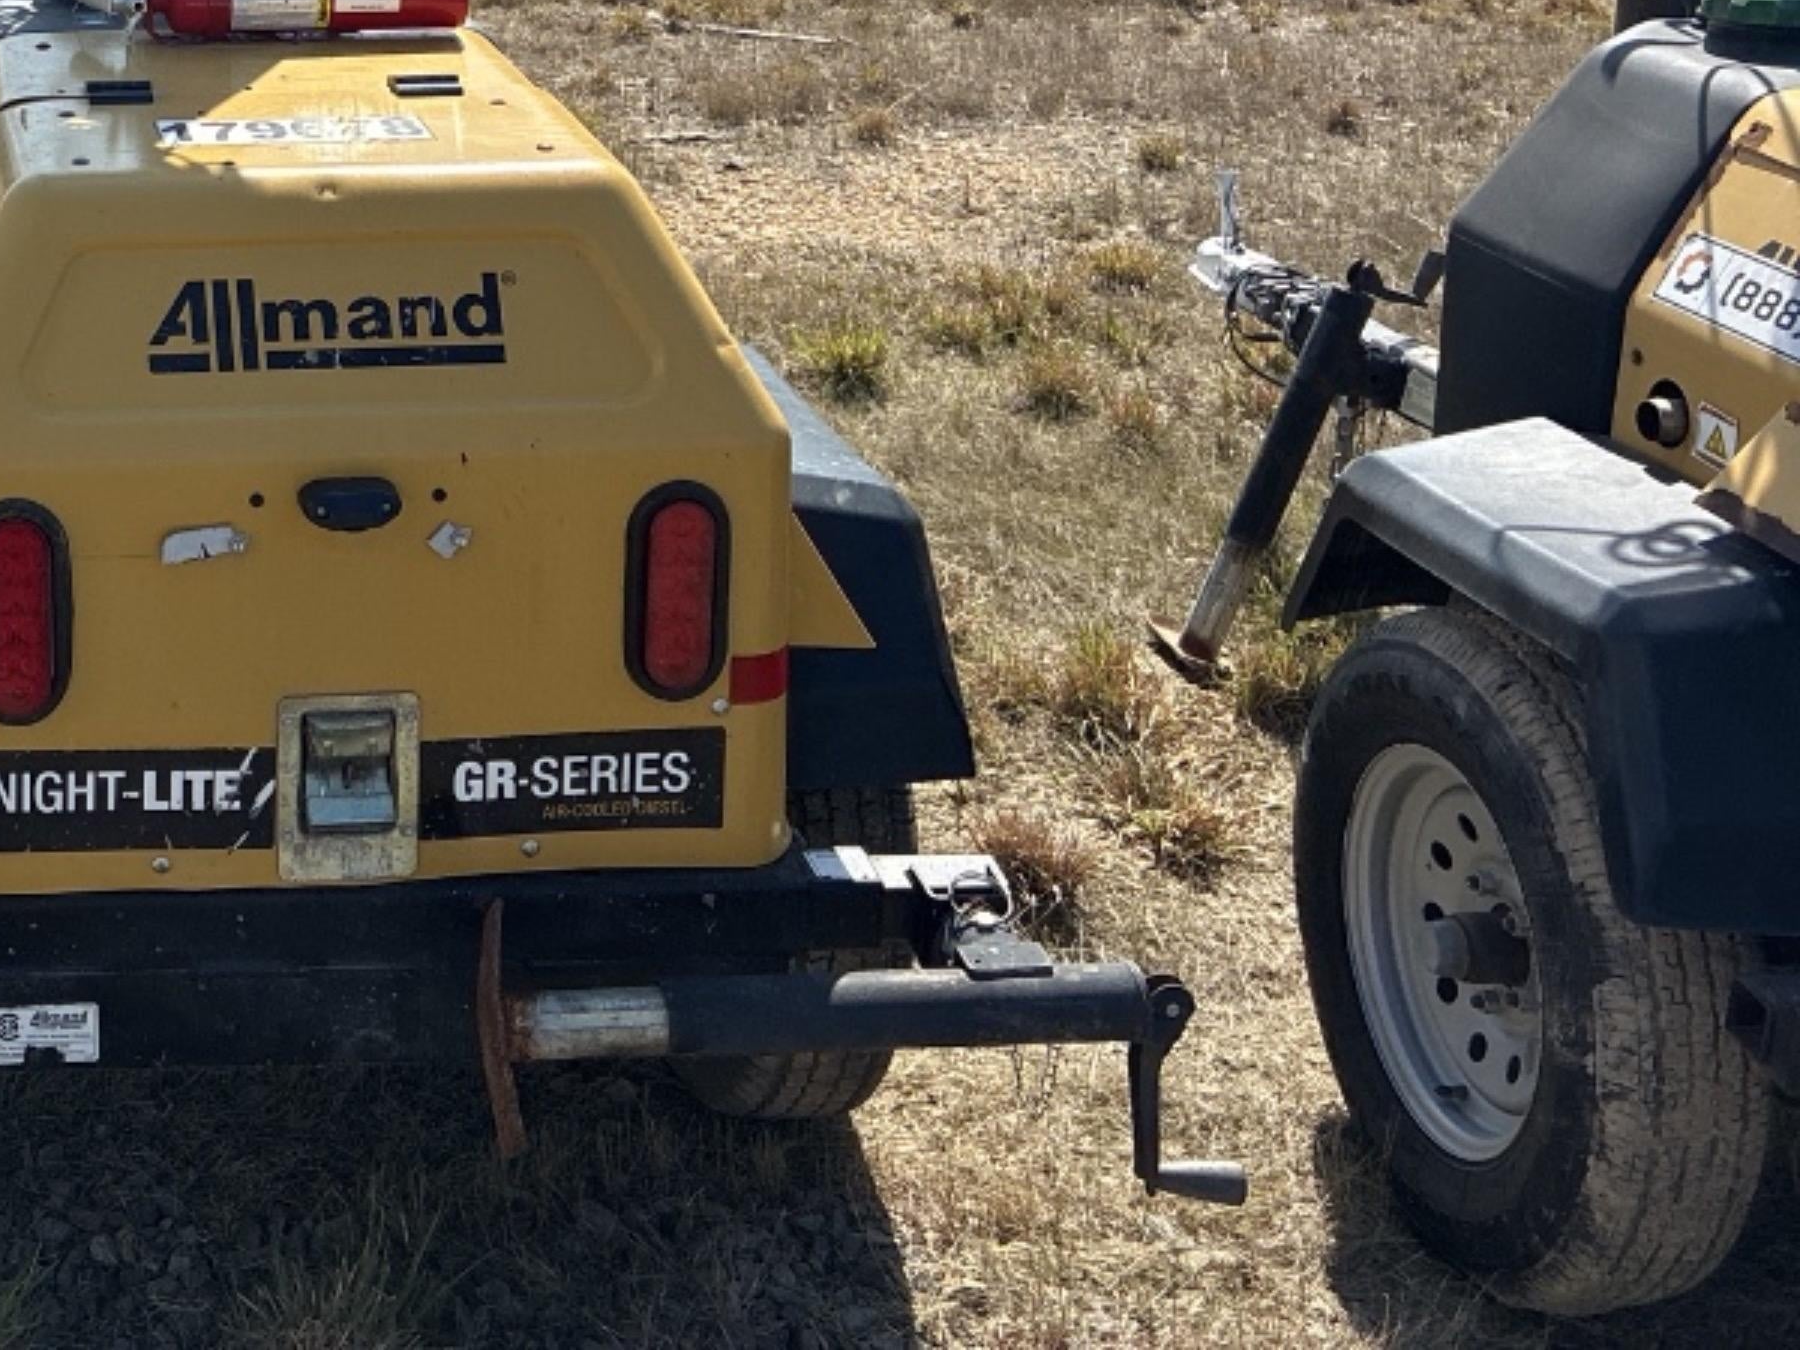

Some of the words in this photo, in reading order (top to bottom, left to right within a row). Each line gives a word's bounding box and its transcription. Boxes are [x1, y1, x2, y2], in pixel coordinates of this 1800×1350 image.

[149, 272, 503, 372] Allmand
[1720, 272, 1800, 339] (888
[453, 751, 691, 802] GR-SERIES
